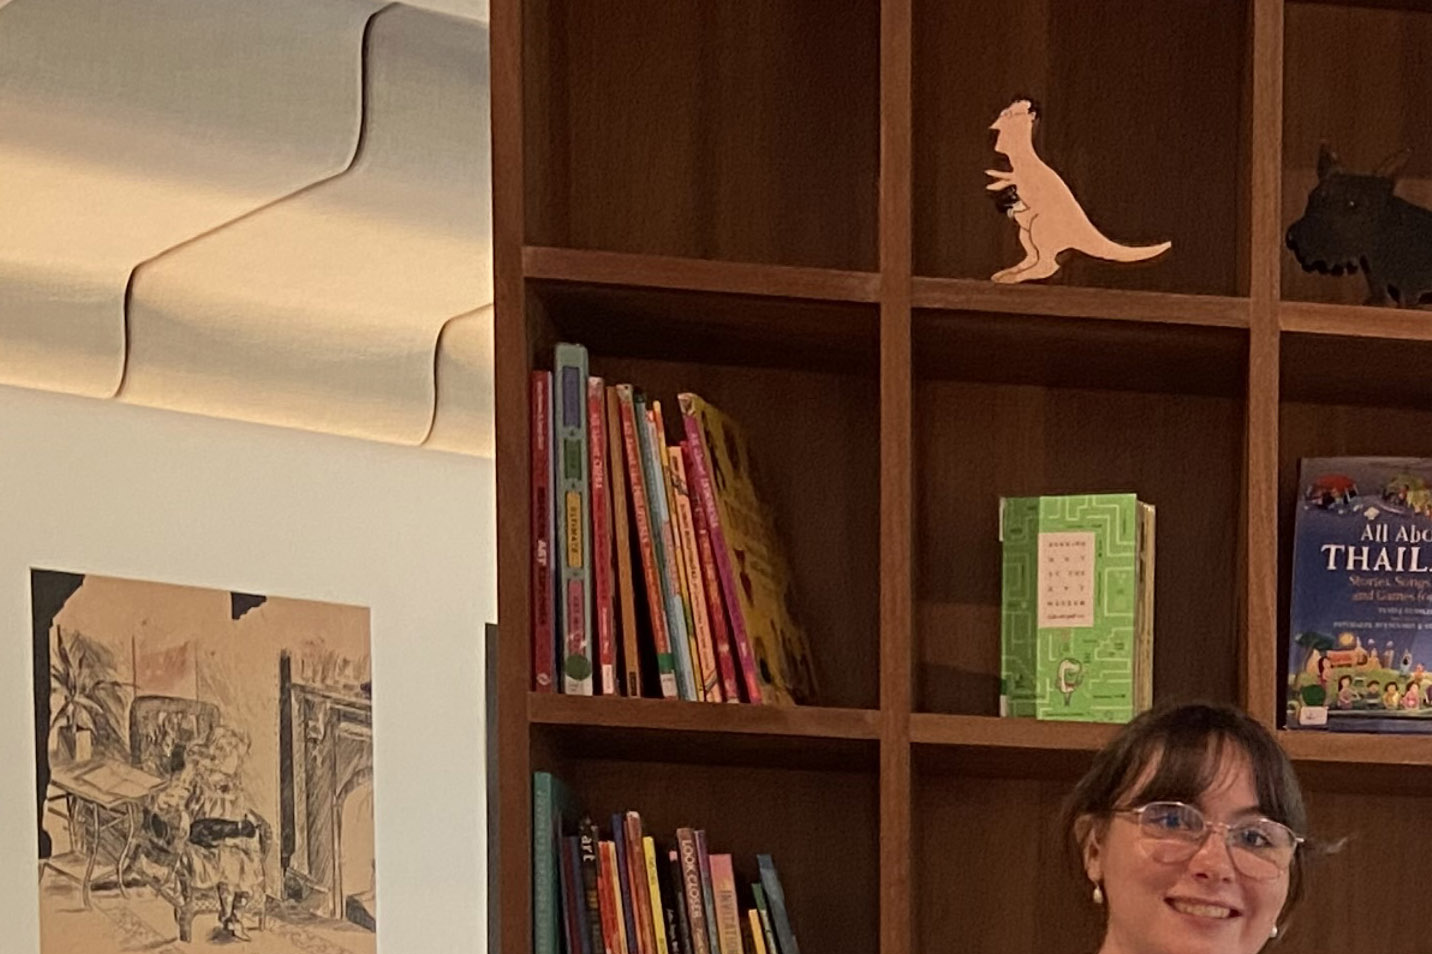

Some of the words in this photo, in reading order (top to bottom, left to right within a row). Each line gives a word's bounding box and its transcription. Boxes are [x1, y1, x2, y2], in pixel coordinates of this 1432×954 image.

[1360, 523, 1388, 542] All
[580, 835, 595, 862] art
[680, 839, 697, 873] LOOK
[686, 873, 702, 919] CLOSER
